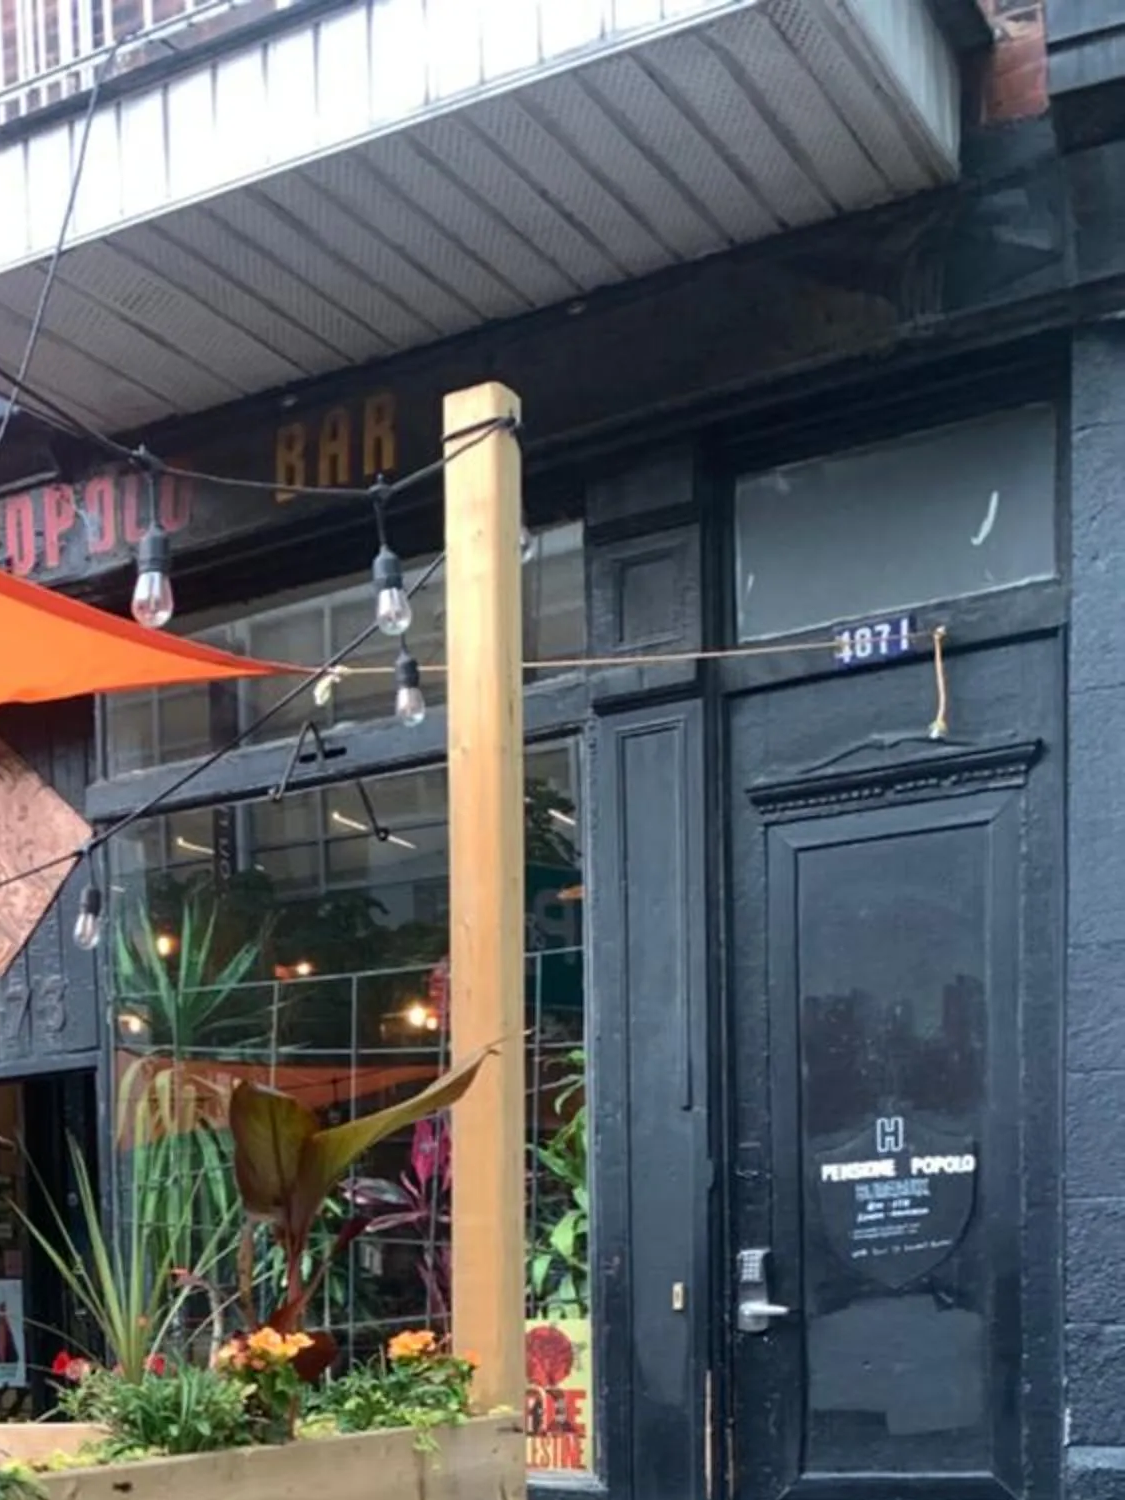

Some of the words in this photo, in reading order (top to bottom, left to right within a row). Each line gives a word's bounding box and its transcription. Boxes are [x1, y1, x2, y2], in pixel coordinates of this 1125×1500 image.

[275, 393, 398, 503] BAR
[835, 618, 909, 663] 4871
[911, 1154, 975, 1175] POPOLO
